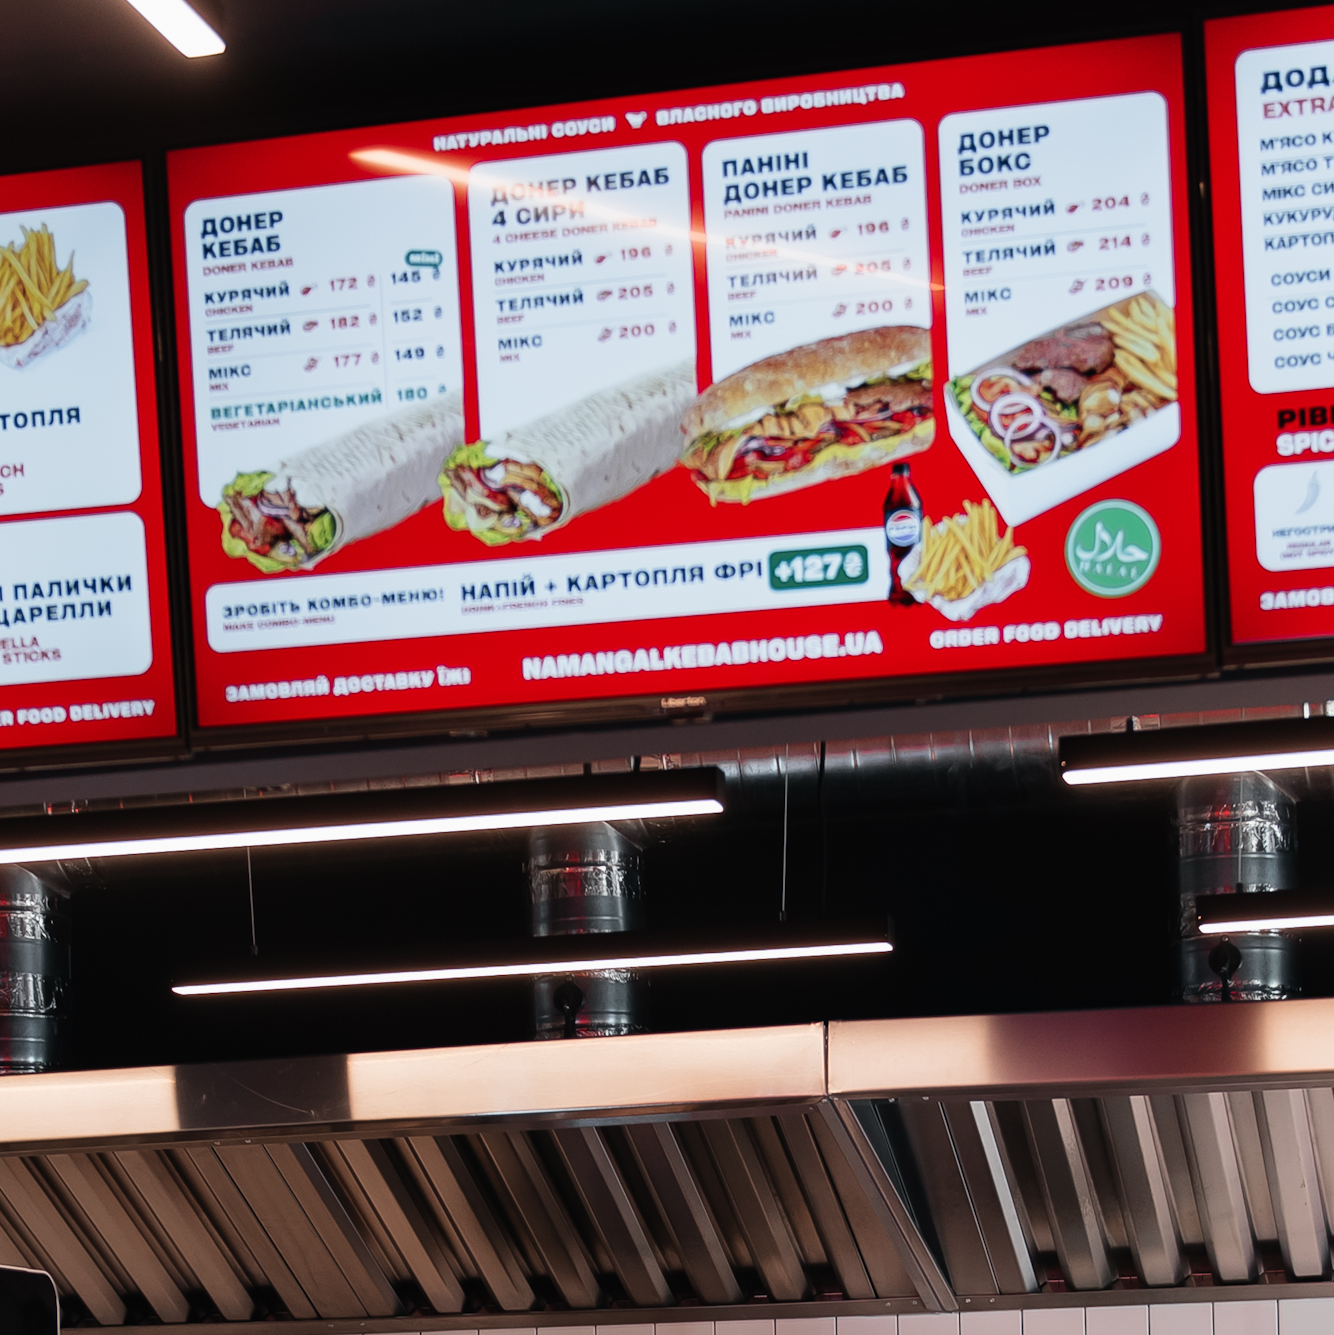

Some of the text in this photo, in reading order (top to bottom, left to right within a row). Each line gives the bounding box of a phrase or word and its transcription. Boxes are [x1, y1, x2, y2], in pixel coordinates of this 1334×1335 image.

[433, 83, 905, 152] НАТУРАЛЬНІ СОУСИ ВЛАСНОГО ВИРОБНИЦТВА
[958, 125, 1050, 154] ДОНЕР
[722, 152, 808, 177] ПАНІНІ
[960, 153, 1031, 176] БОКС
[491, 167, 669, 207] ДОНЕР КЕБАБ
[724, 166, 908, 205] ДОНЕР КЕБАБ
[492, 211, 507, 226] 4
[962, 196, 1130, 224] КУРЯЧИЙ 204
[201, 211, 283, 239] ДОНЕР
[203, 235, 281, 259] КЕБАБ
[205, 280, 290, 304] КУРЯЧИЙ
[330, 277, 357, 291] 172
[1272, 297, 1318, 313] СОУС
[1273, 325, 1320, 341] СОУС
[1274, 352, 1321, 369] СОУС
[211, 390, 382, 420] ВЕГЕТАРІАНСЬКИЙ
[1076, 521, 1149, 563] حلال
[14, 575, 132, 600] ПАЛИЧКИ
[462, 574, 535, 601] НАПІЙ
[567, 559, 705, 593] КАРТОПЛЯ
[715, 561, 762, 582] ФРІ
[930, 615, 1162, 649] ORDER FOOD DELIVERY
[3, 649, 61, 664] STICKS
[522, 630, 884, 680] NAMANGALKEBABHOUSE.UA
[226, 665, 470, 702] ЗАМОВЛЯЙ ДОСТАВКУ ЇЖІ
[18, 706, 66, 724] FOOD
[70, 700, 155, 721] DELIVERY
